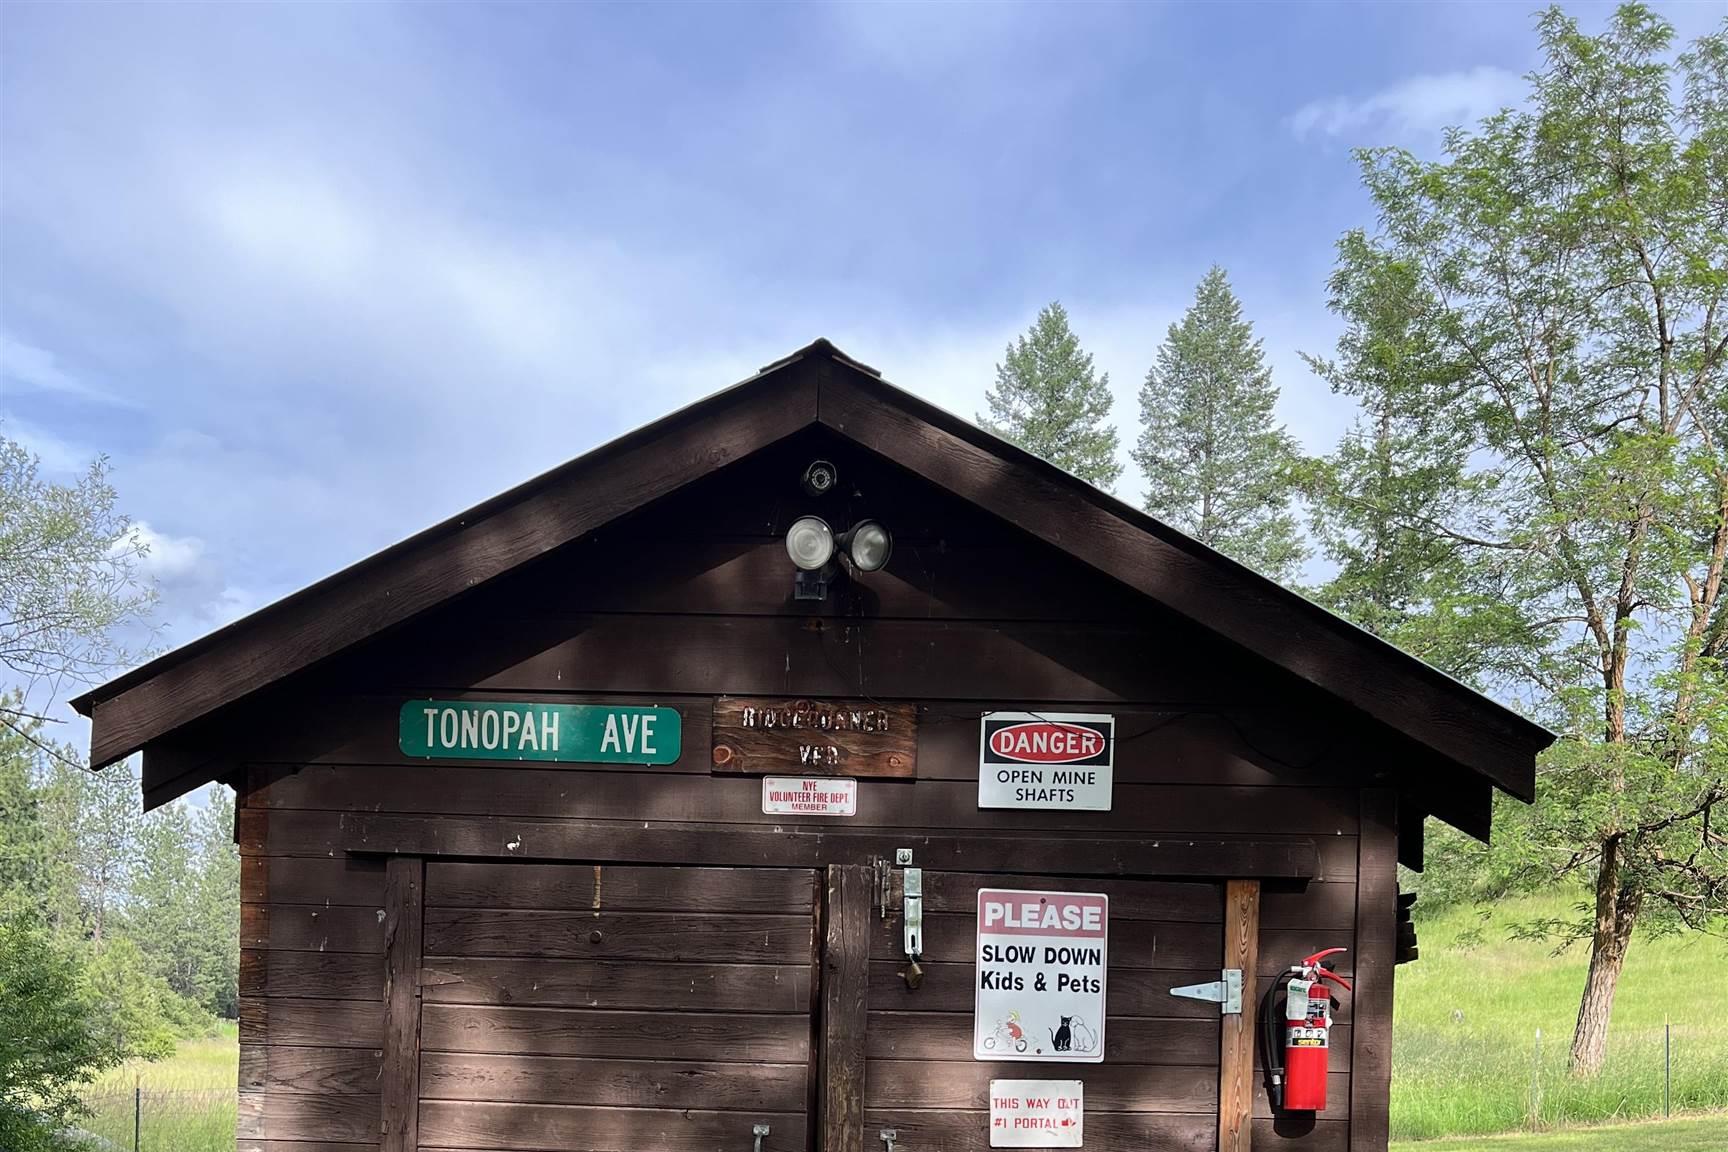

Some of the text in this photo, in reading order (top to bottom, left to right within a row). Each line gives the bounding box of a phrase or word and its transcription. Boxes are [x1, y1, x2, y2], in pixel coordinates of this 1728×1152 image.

[423, 708, 657, 754] TONOPAH AVE
[1000, 731, 1097, 754] DANGER
[997, 770, 1096, 785] OPEN MINE
[802, 780, 817, 792] NYE
[769, 791, 811, 803] VOLUNTEER
[813, 793, 829, 804] FIRE
[1015, 788, 1075, 803] SHAFTS
[791, 802, 828, 811] MEMBER
[984, 901, 1102, 931] PLEASE
[982, 944, 1101, 966] SLOW DOWN
[981, 970, 1101, 994] Kids & Pets
[993, 1098, 1019, 1109] THIS
[1026, 1099, 1050, 1109] WAY
[994, 1118, 1058, 1128] #1 PORTAL
